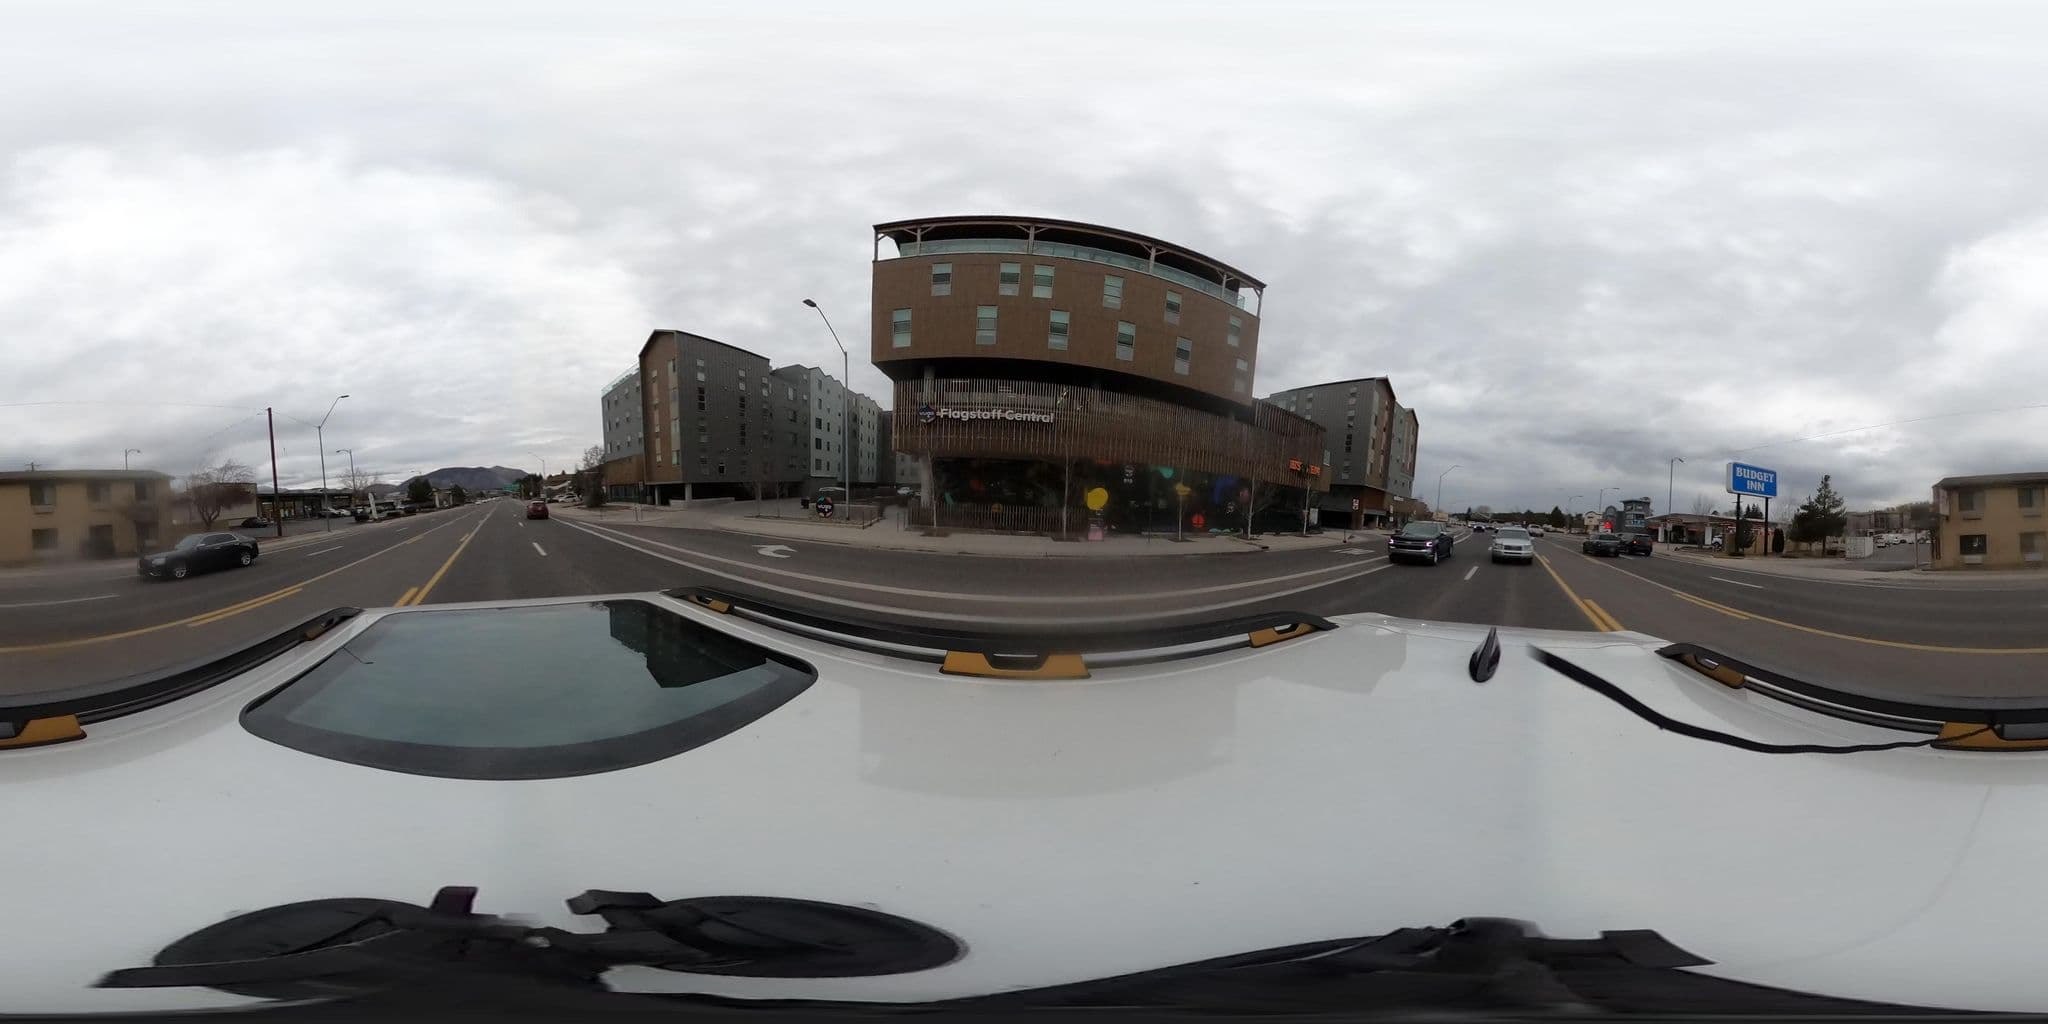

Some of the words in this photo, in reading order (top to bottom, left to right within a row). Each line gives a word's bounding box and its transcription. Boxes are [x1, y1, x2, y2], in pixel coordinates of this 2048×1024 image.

[940, 408, 1002, 421] Flagstaff
[1005, 410, 1055, 423] Central
[1736, 467, 1774, 482] BUDGET
[1747, 480, 1765, 491] INN
